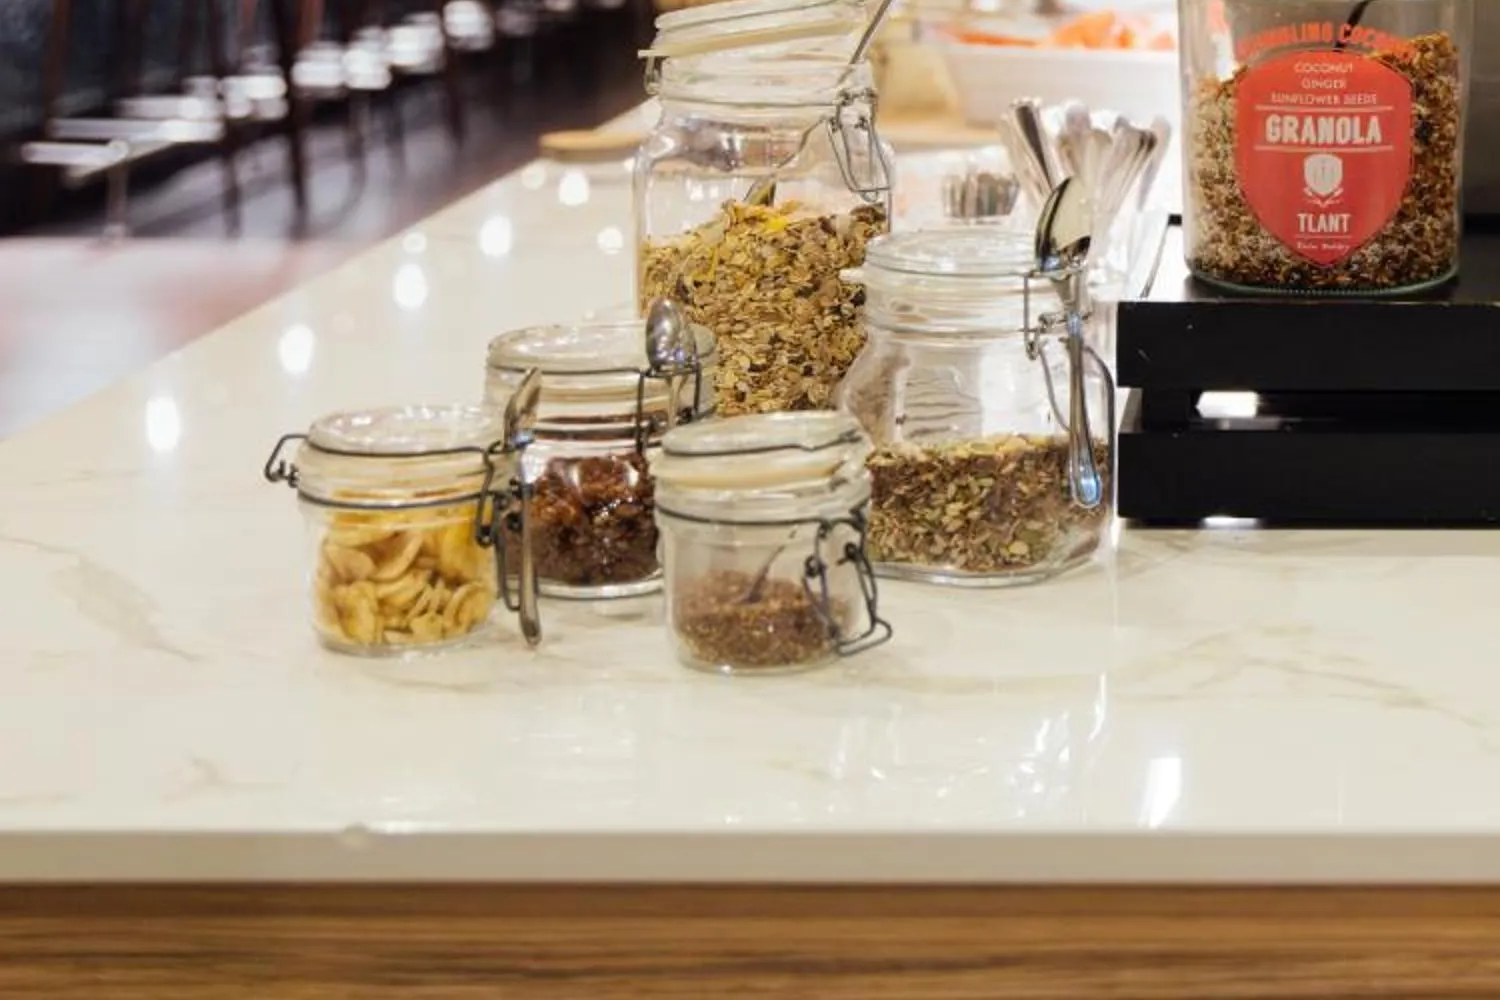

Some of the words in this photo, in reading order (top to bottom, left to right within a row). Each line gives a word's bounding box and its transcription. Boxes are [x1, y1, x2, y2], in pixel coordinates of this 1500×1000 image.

[1294, 61, 1353, 73] COCONUT
[1301, 78, 1347, 90] GINGER
[1265, 114, 1382, 144] GRANOLA
[1297, 212, 1351, 233] TLANT
